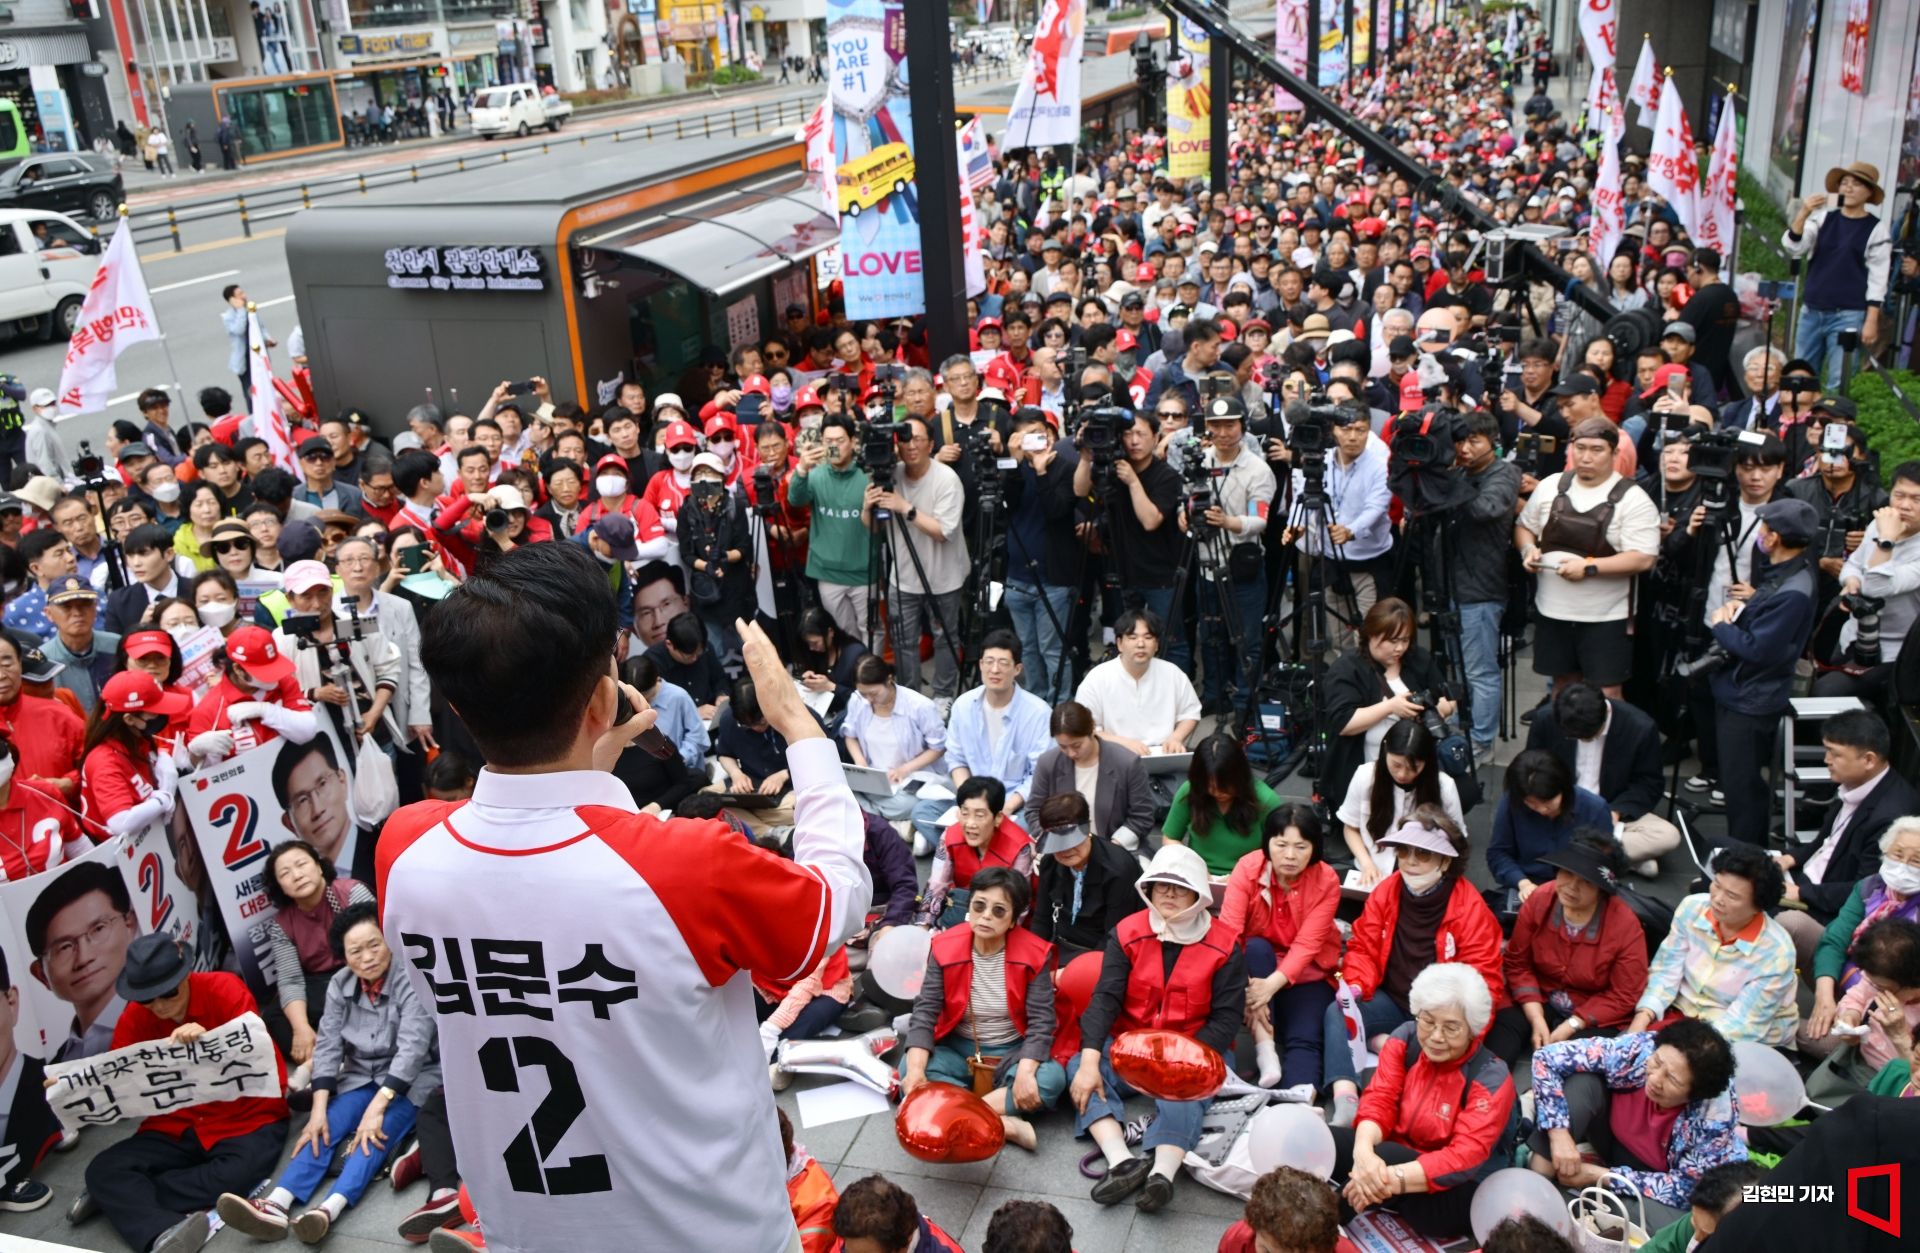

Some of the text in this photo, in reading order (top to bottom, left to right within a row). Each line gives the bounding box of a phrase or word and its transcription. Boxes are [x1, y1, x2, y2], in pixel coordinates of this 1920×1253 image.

[832, 37, 868, 55] YOU
[836, 53, 870, 71] ARE
[842, 71, 866, 93] #1
[1170, 139, 1210, 155] LOVE
[384, 248, 540, 275] 천안시 관광안내소
[844, 250, 921, 277] LOVE
[211, 765, 246, 785] 국민의힘
[208, 793, 272, 872] 2
[138, 852, 174, 932] 2
[401, 931, 639, 1022] 김문수
[477, 1035, 613, 1196] 2
